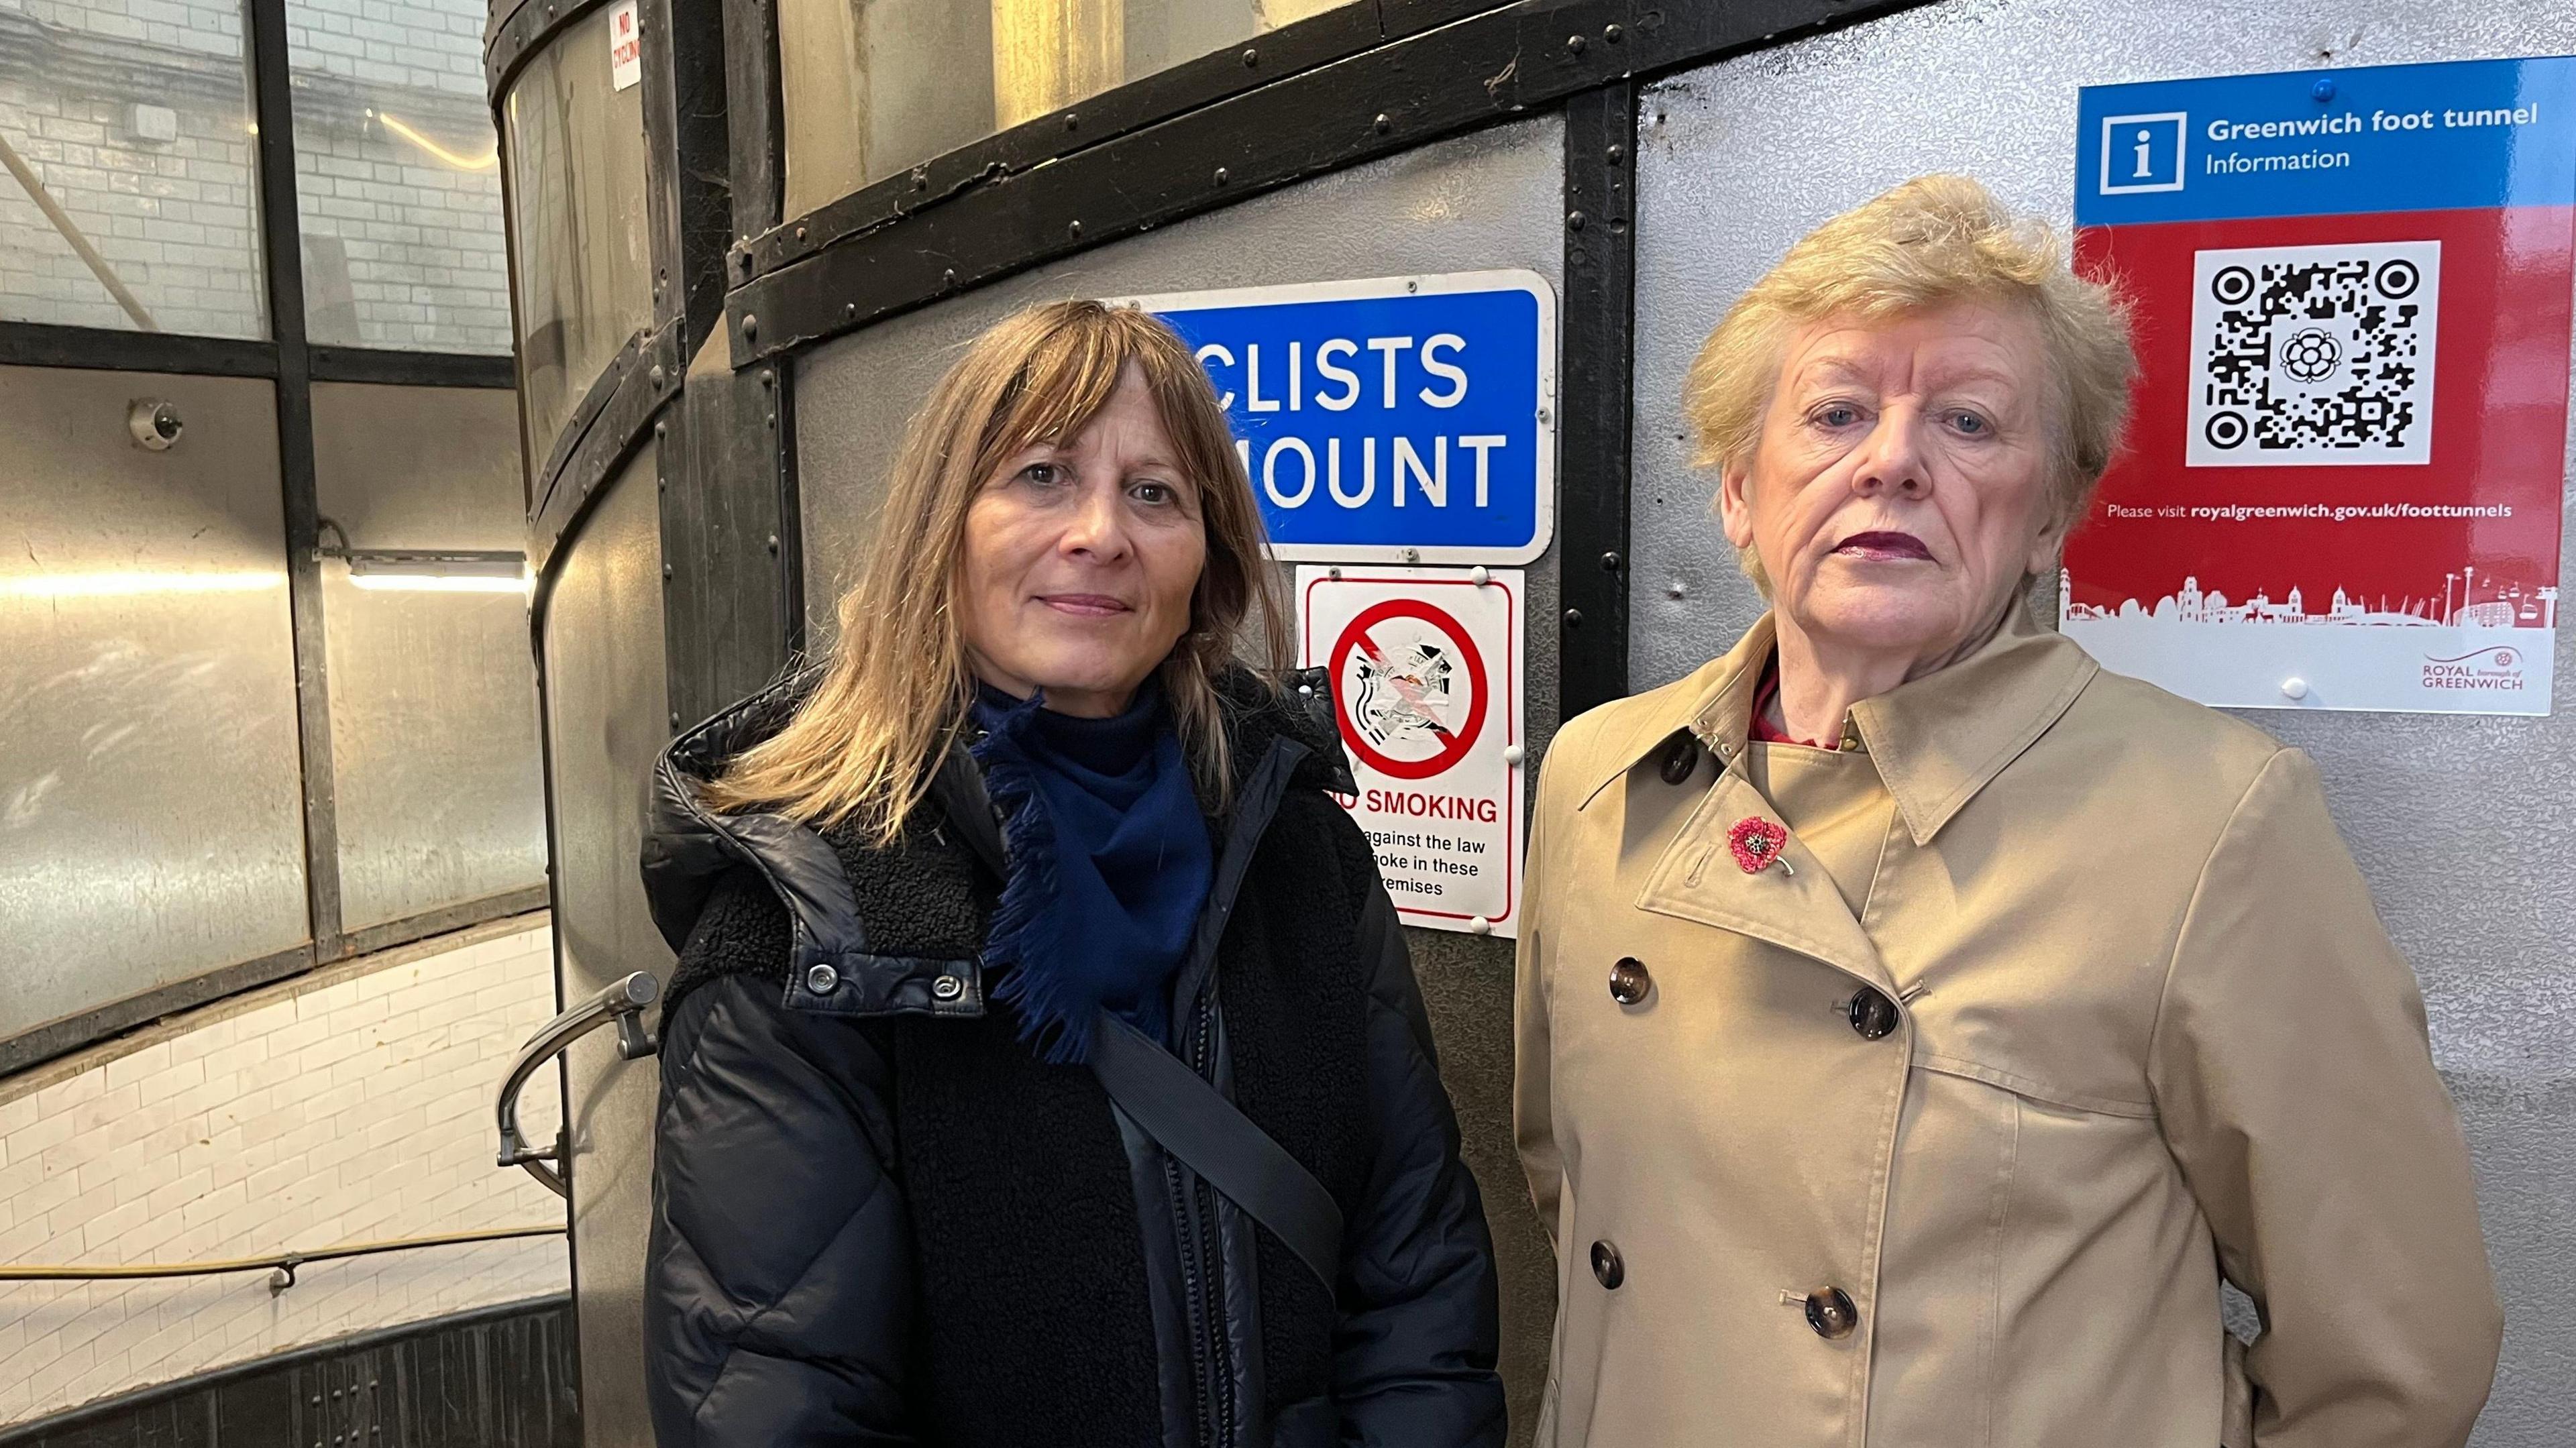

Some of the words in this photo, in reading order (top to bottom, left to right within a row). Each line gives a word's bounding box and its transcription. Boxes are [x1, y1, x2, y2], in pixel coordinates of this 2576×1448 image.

[619, 11, 631, 37] NO
[2207, 112, 2361, 142] Greenwich
[2371, 109, 2434, 132] foot
[2443, 102, 2539, 129] tunnel
[2206, 150, 2349, 174] Information
[2107, 504, 2153, 518] Please
[2157, 504, 2186, 518] visit
[2190, 502, 2512, 522] royalgreenwich.gov.uk/foottunnels
[2422, 677, 2523, 690] GREENWICH
[2423, 665, 2473, 677] ROYAL
[2477, 669, 2511, 678] borough
[1366, 789, 1497, 823] SMOKING
[1364, 830, 1421, 848] against
[1426, 834, 1452, 850] the
[1458, 837, 1485, 854] law
[1413, 856, 1428, 871] in
[1433, 858, 1479, 877] these
